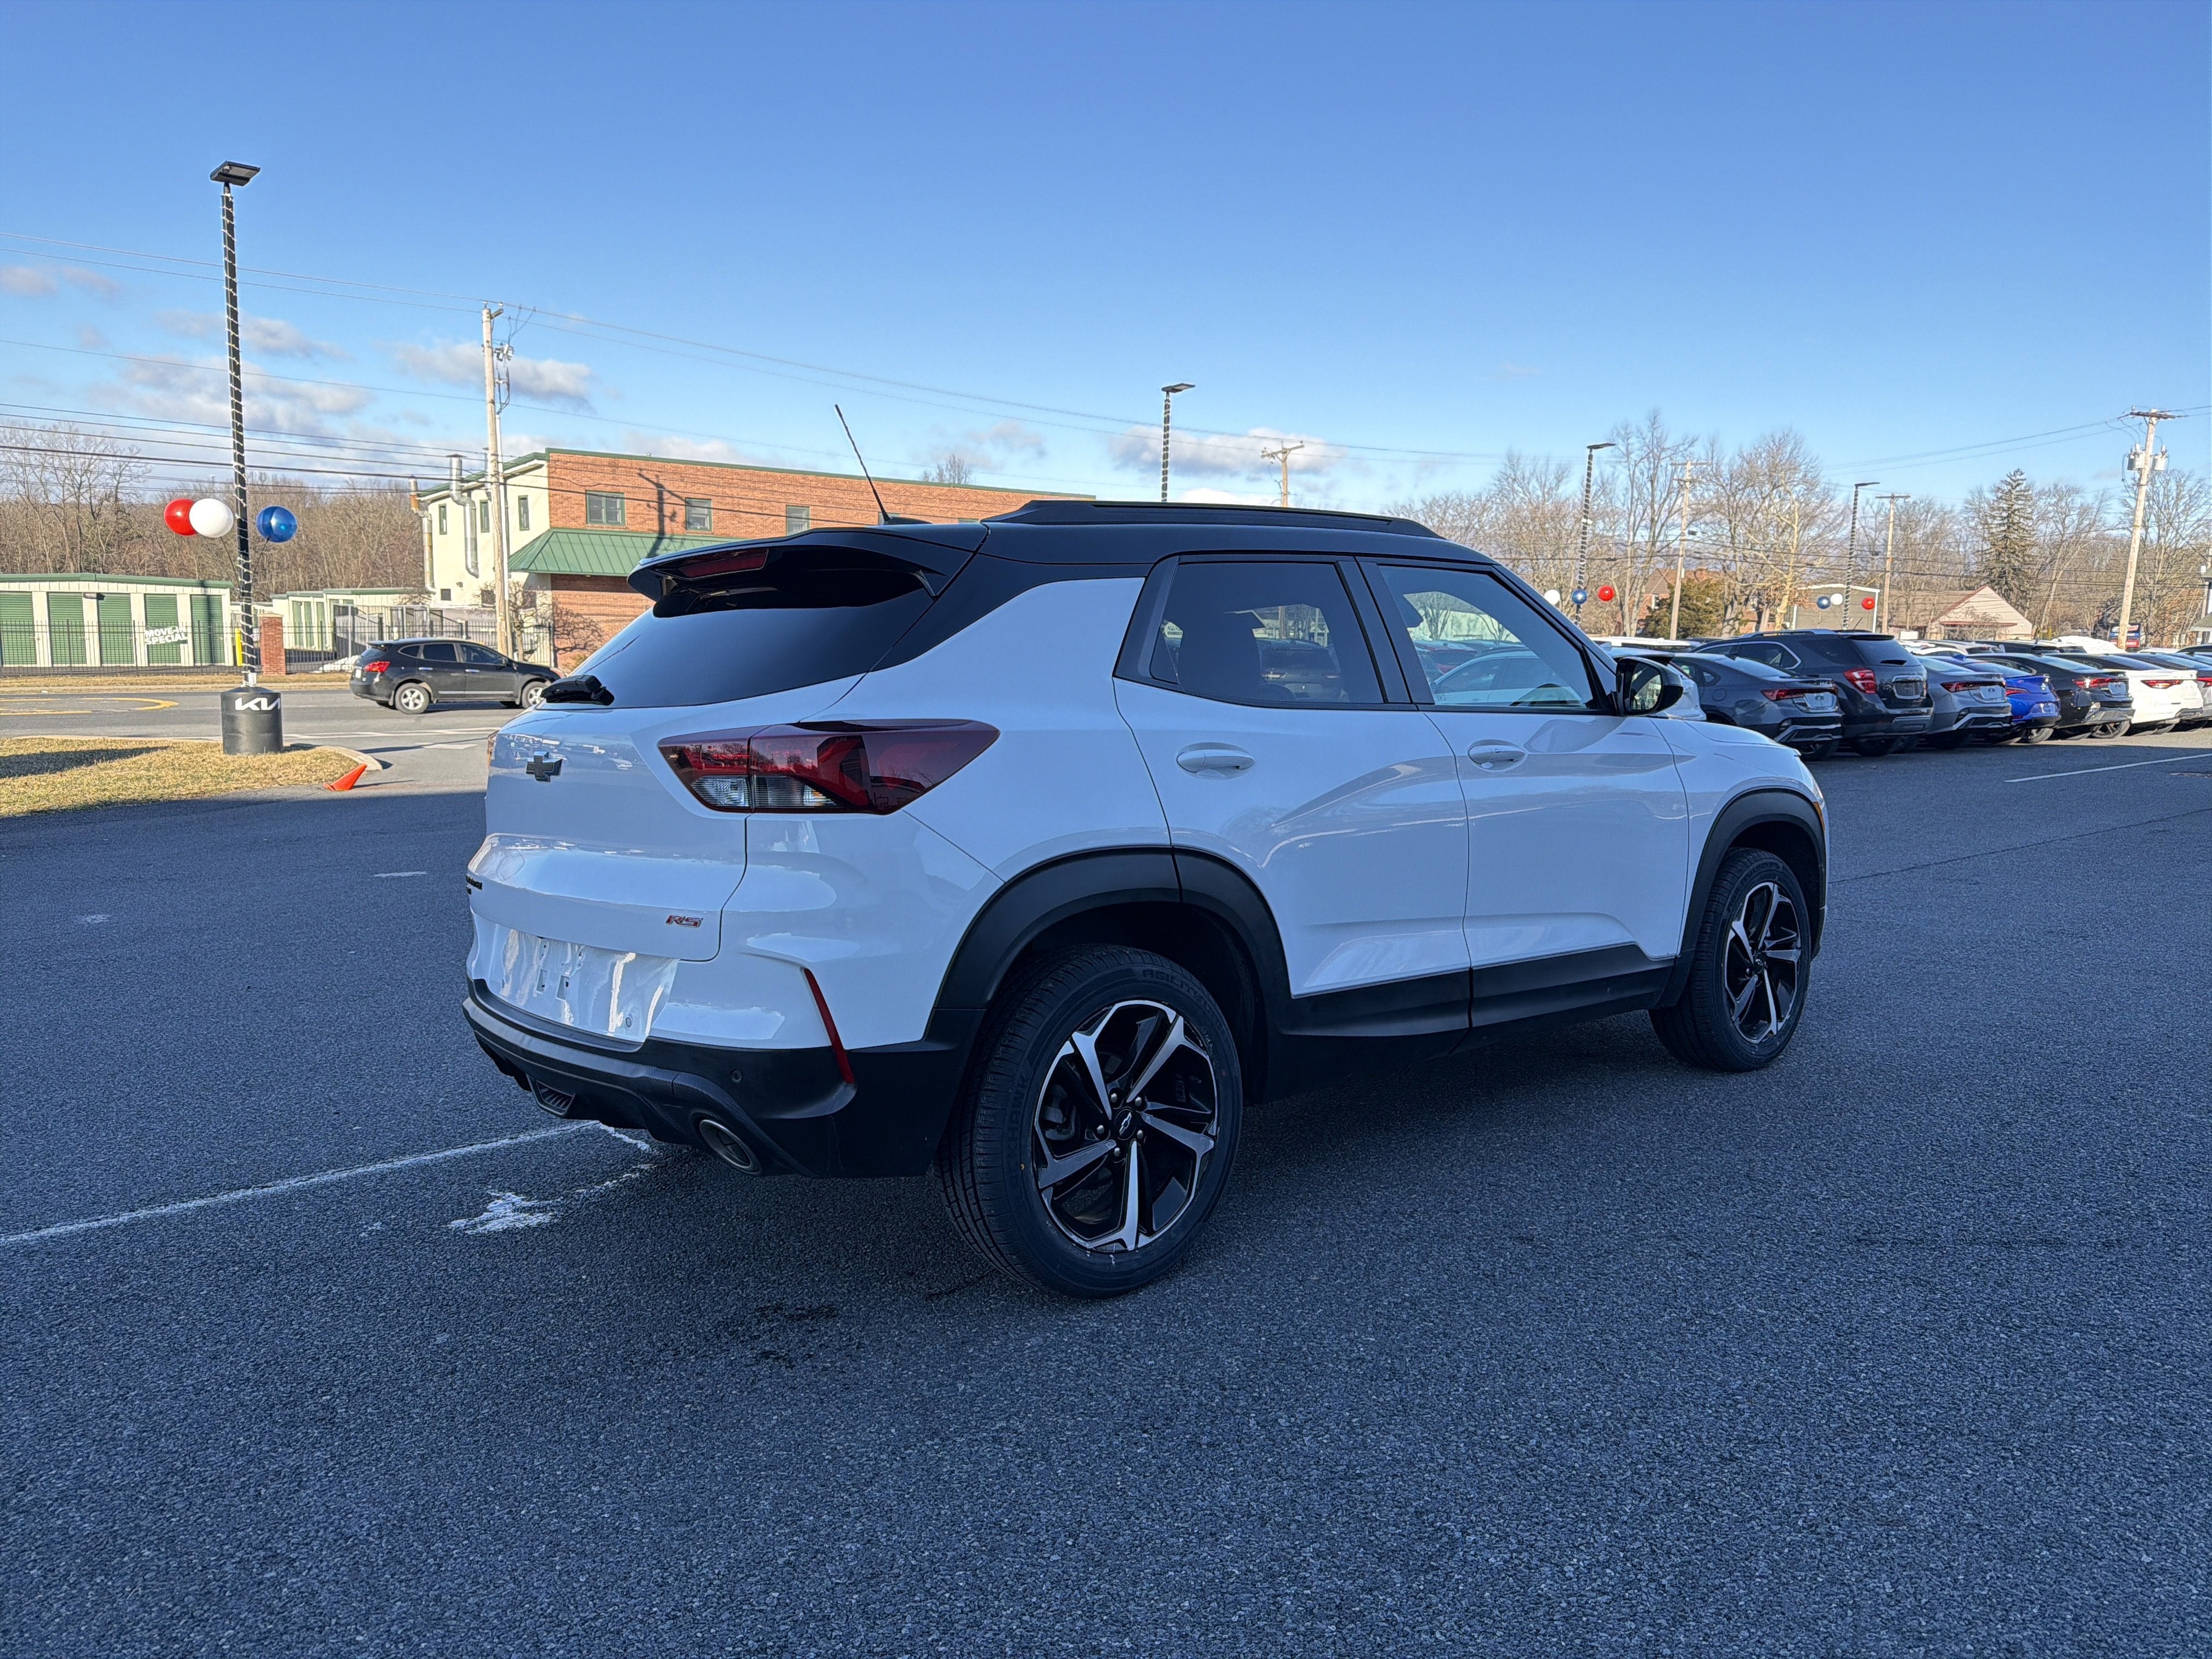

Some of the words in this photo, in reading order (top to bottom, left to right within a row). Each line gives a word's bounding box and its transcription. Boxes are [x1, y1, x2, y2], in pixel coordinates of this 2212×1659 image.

[145, 627, 187, 637] MOVE-IN
[145, 633, 188, 645] SPECIAL
[235, 697, 280, 710] KIA
[665, 915, 704, 928] RS
